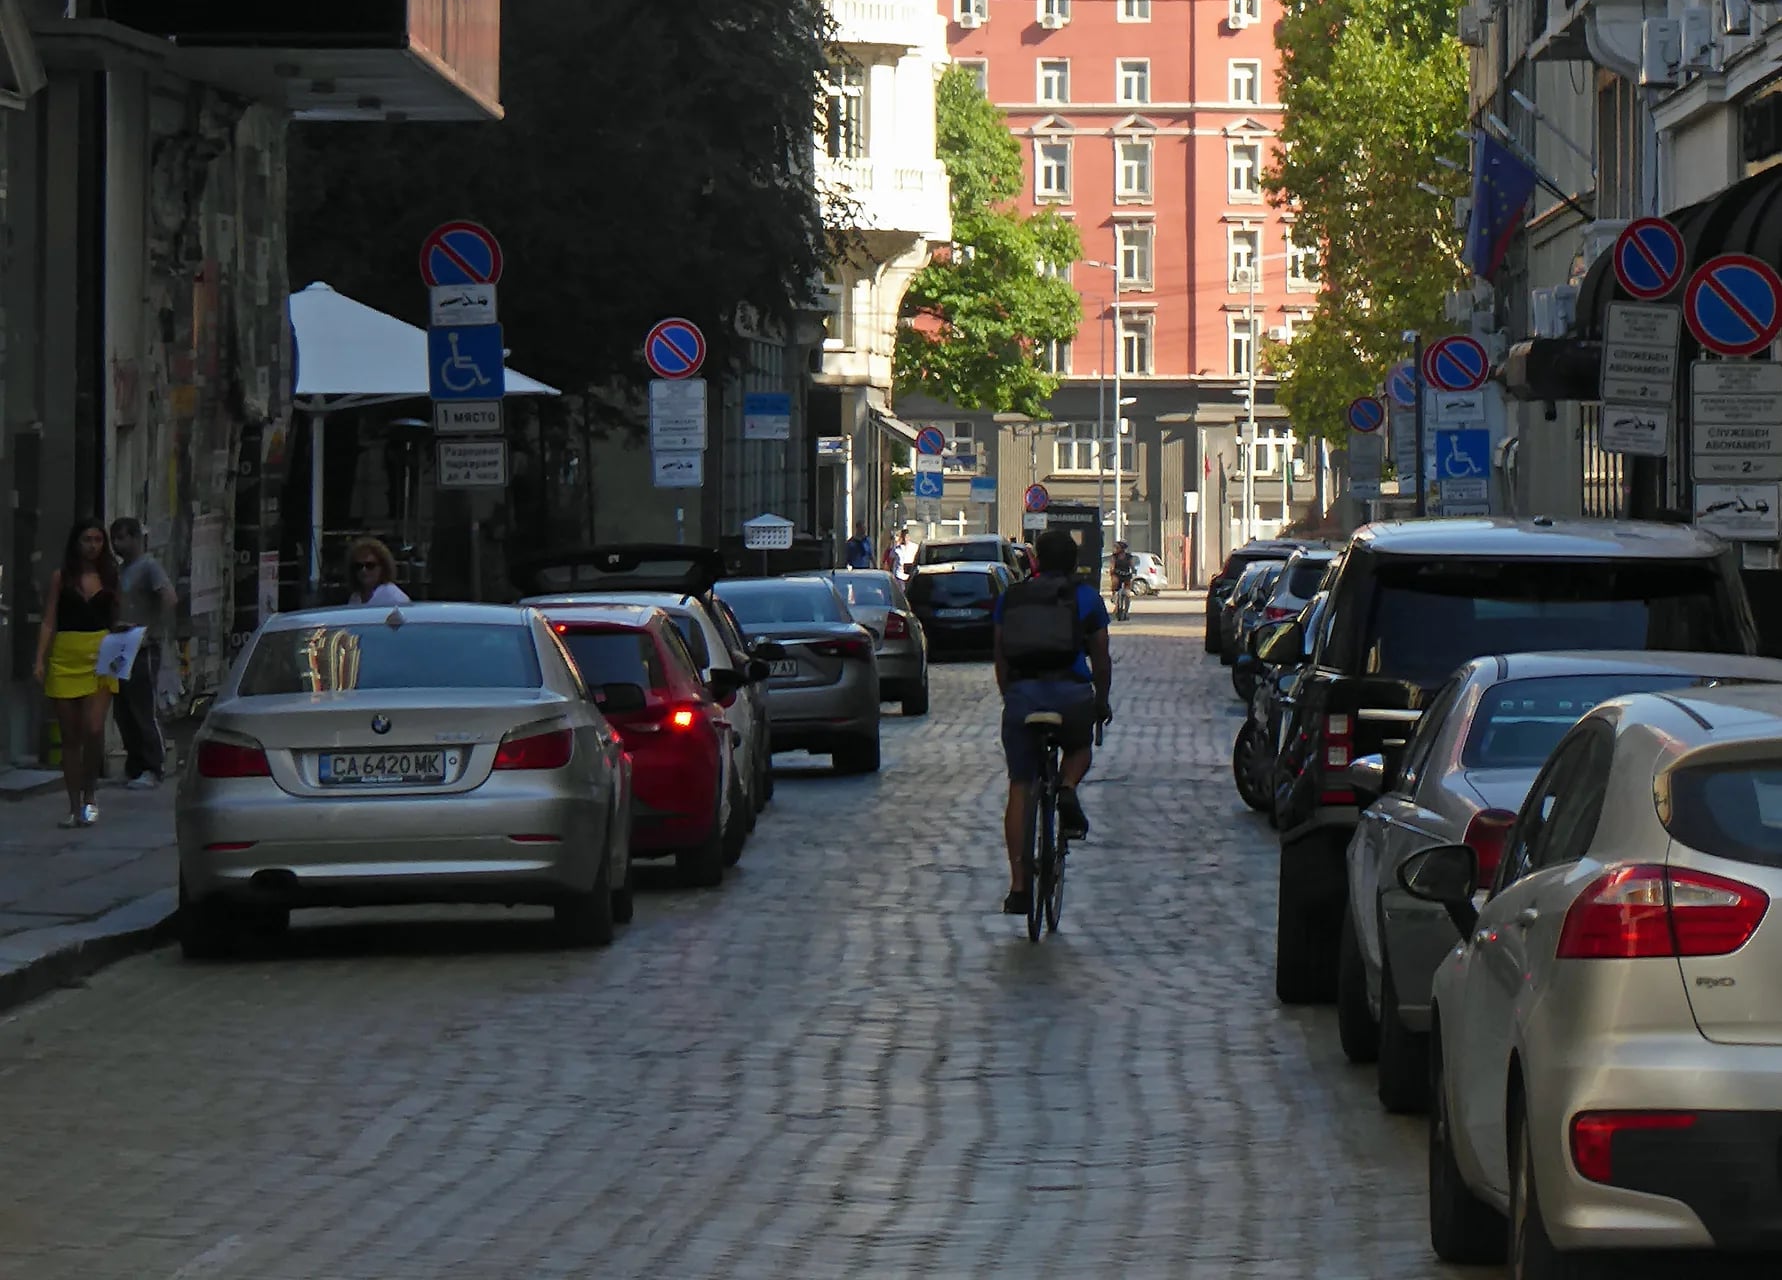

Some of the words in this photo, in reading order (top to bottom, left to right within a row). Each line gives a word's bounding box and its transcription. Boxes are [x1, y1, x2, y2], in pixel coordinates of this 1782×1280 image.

[1640, 386, 1648, 396] 2
[443, 409, 448, 424] 1
[1705, 440, 1771, 450] АБОНАМЕНТ
[1742, 461, 1751, 473] 2
[333, 756, 358, 775] CA
[363, 754, 410, 774] 6420
[414, 754, 439, 773] MK
